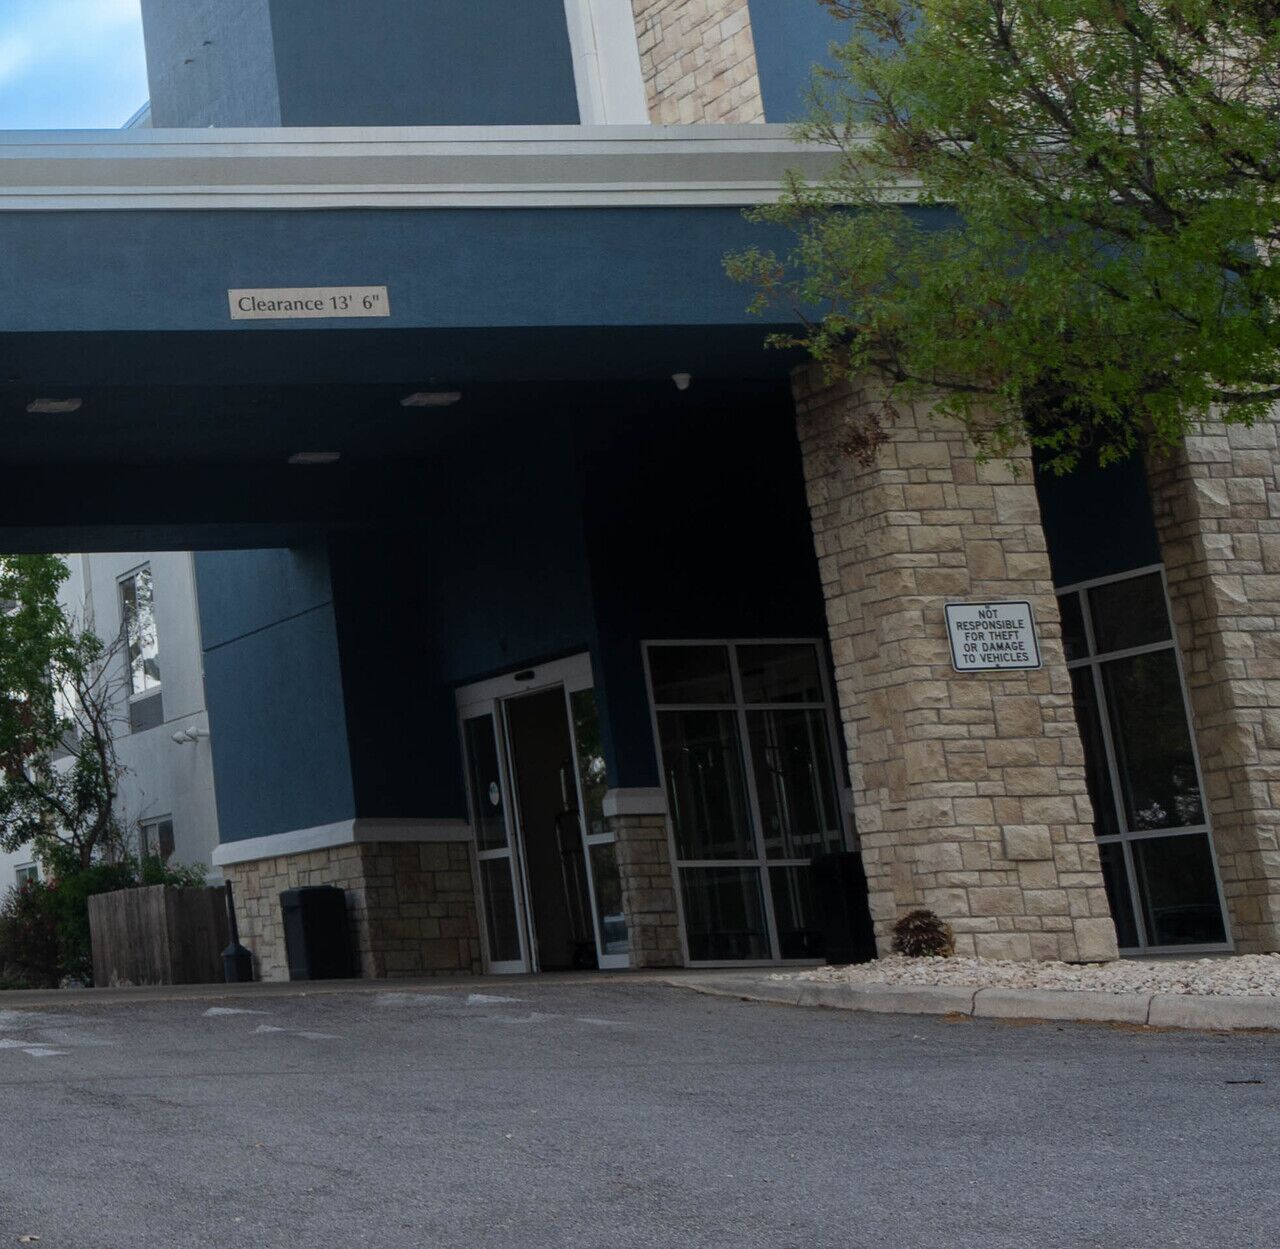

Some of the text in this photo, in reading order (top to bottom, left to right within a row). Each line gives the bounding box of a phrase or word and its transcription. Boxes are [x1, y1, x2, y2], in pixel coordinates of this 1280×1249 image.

[238, 296, 324, 312] Clearance
[329, 295, 353, 310] 13'
[978, 609, 998, 619] NOT
[956, 619, 1025, 630] RESPONSIBLE
[965, 630, 1020, 641] FOR THEFT
[963, 641, 1025, 652] OR DAMAGE
[962, 652, 1029, 663] TO VEHICLES
